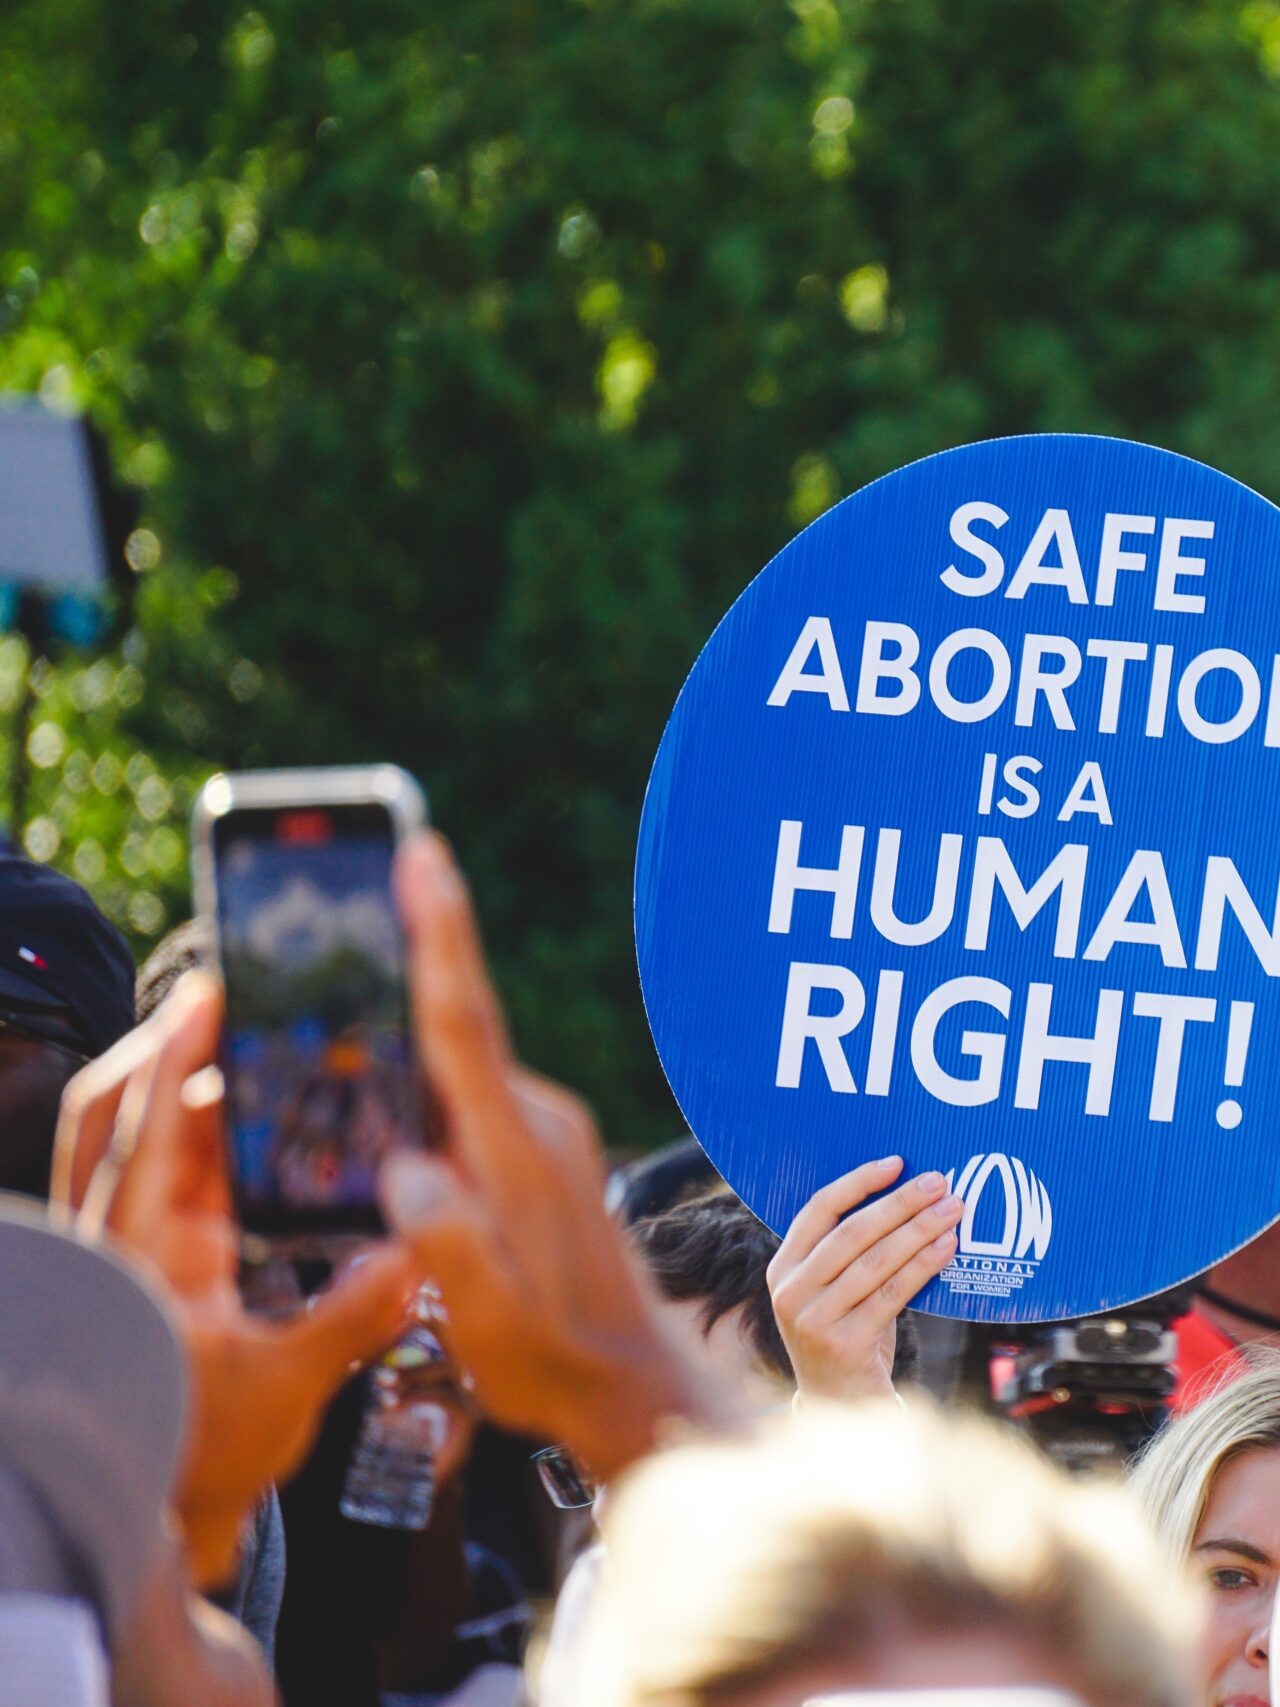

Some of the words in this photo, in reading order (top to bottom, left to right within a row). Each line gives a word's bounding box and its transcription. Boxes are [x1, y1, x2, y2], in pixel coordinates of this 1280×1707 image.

[940, 502, 1214, 613] SAFE
[978, 753, 1042, 818] IS
[1058, 761, 1113, 825] A
[776, 962, 1254, 1130] RIGHT!
[940, 1270, 1024, 1285] ORGANIZATION
[948, 1258, 1034, 1275] ATIONAL
[950, 1283, 970, 1291] FOR
[973, 1285, 1011, 1294] WOMEN
